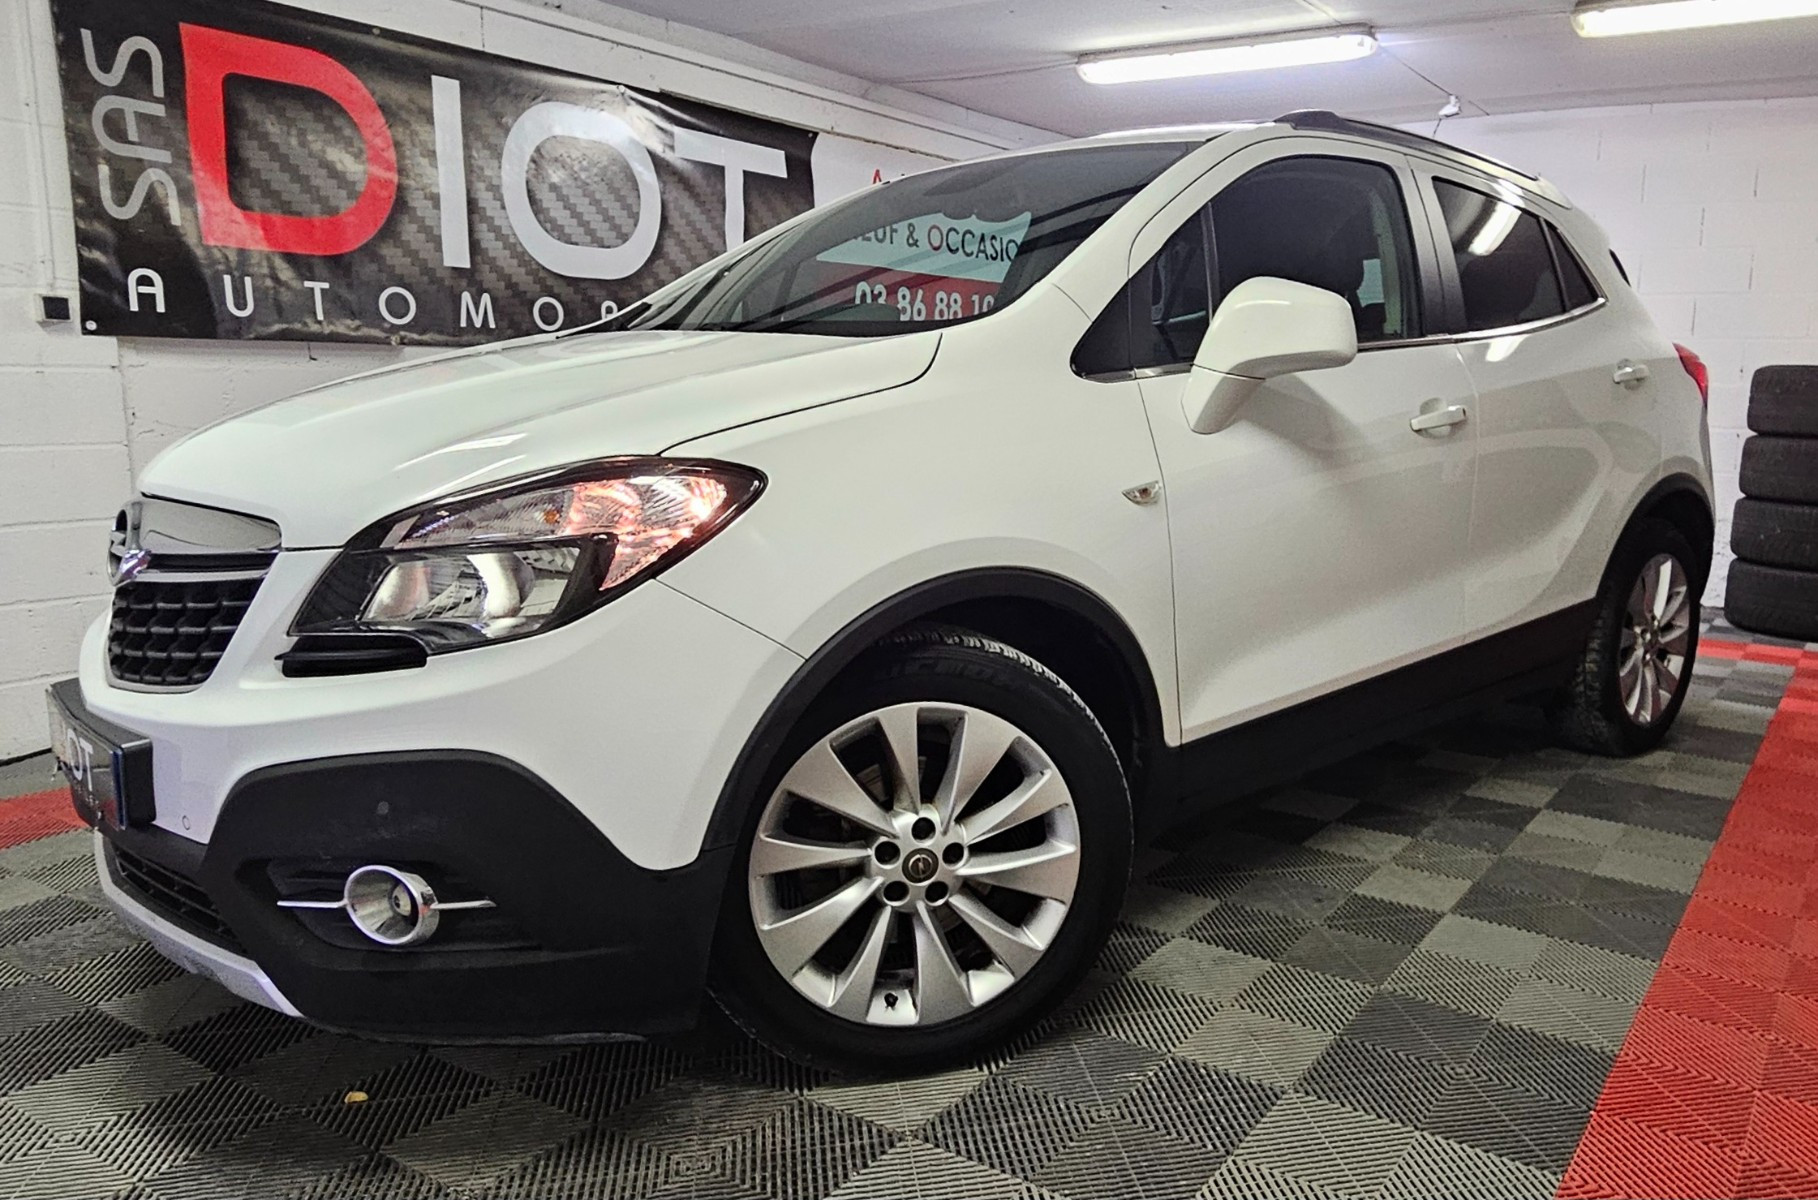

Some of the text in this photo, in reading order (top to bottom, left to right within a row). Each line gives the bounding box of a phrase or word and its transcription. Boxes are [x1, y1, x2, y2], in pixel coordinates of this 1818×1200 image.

[81, 28, 181, 226] SAS
[179, 22, 787, 280] DIOT
[906, 222, 919, 248] &
[897, 287, 926, 321] 86
